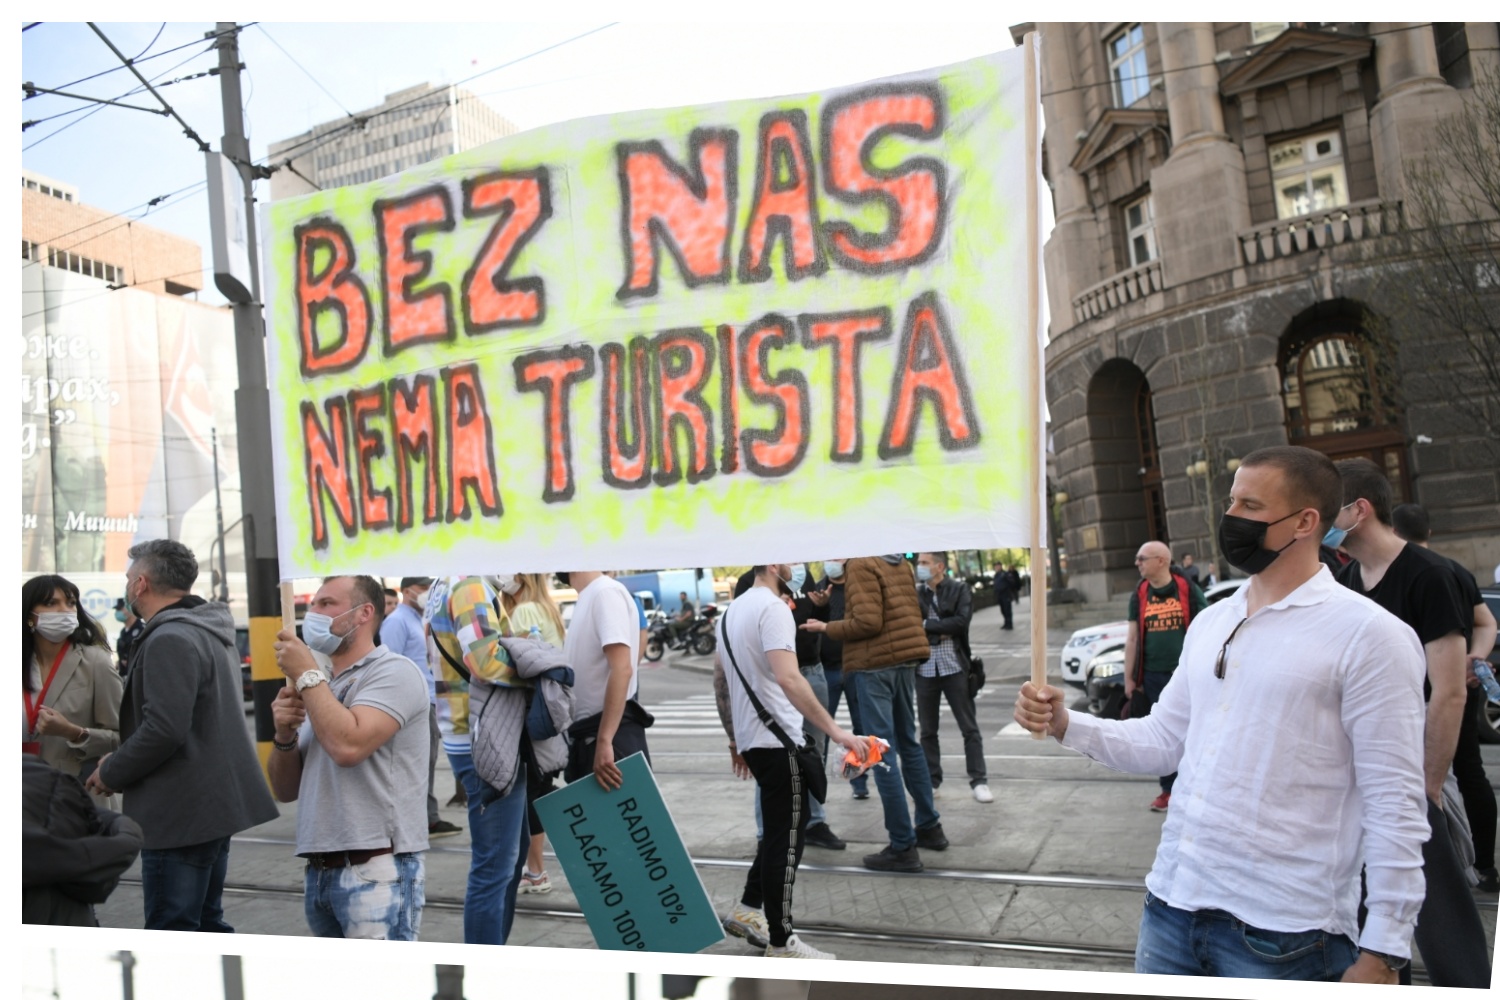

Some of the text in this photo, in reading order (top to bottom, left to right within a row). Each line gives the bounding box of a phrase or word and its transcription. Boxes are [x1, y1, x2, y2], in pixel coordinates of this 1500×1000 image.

[294, 78, 948, 378] BEZ NAS
[300, 291, 981, 550] NEMA TURISTA
[563, 804, 623, 907] PLAĆAMO
[617, 797, 687, 924] RADIMO 10%
